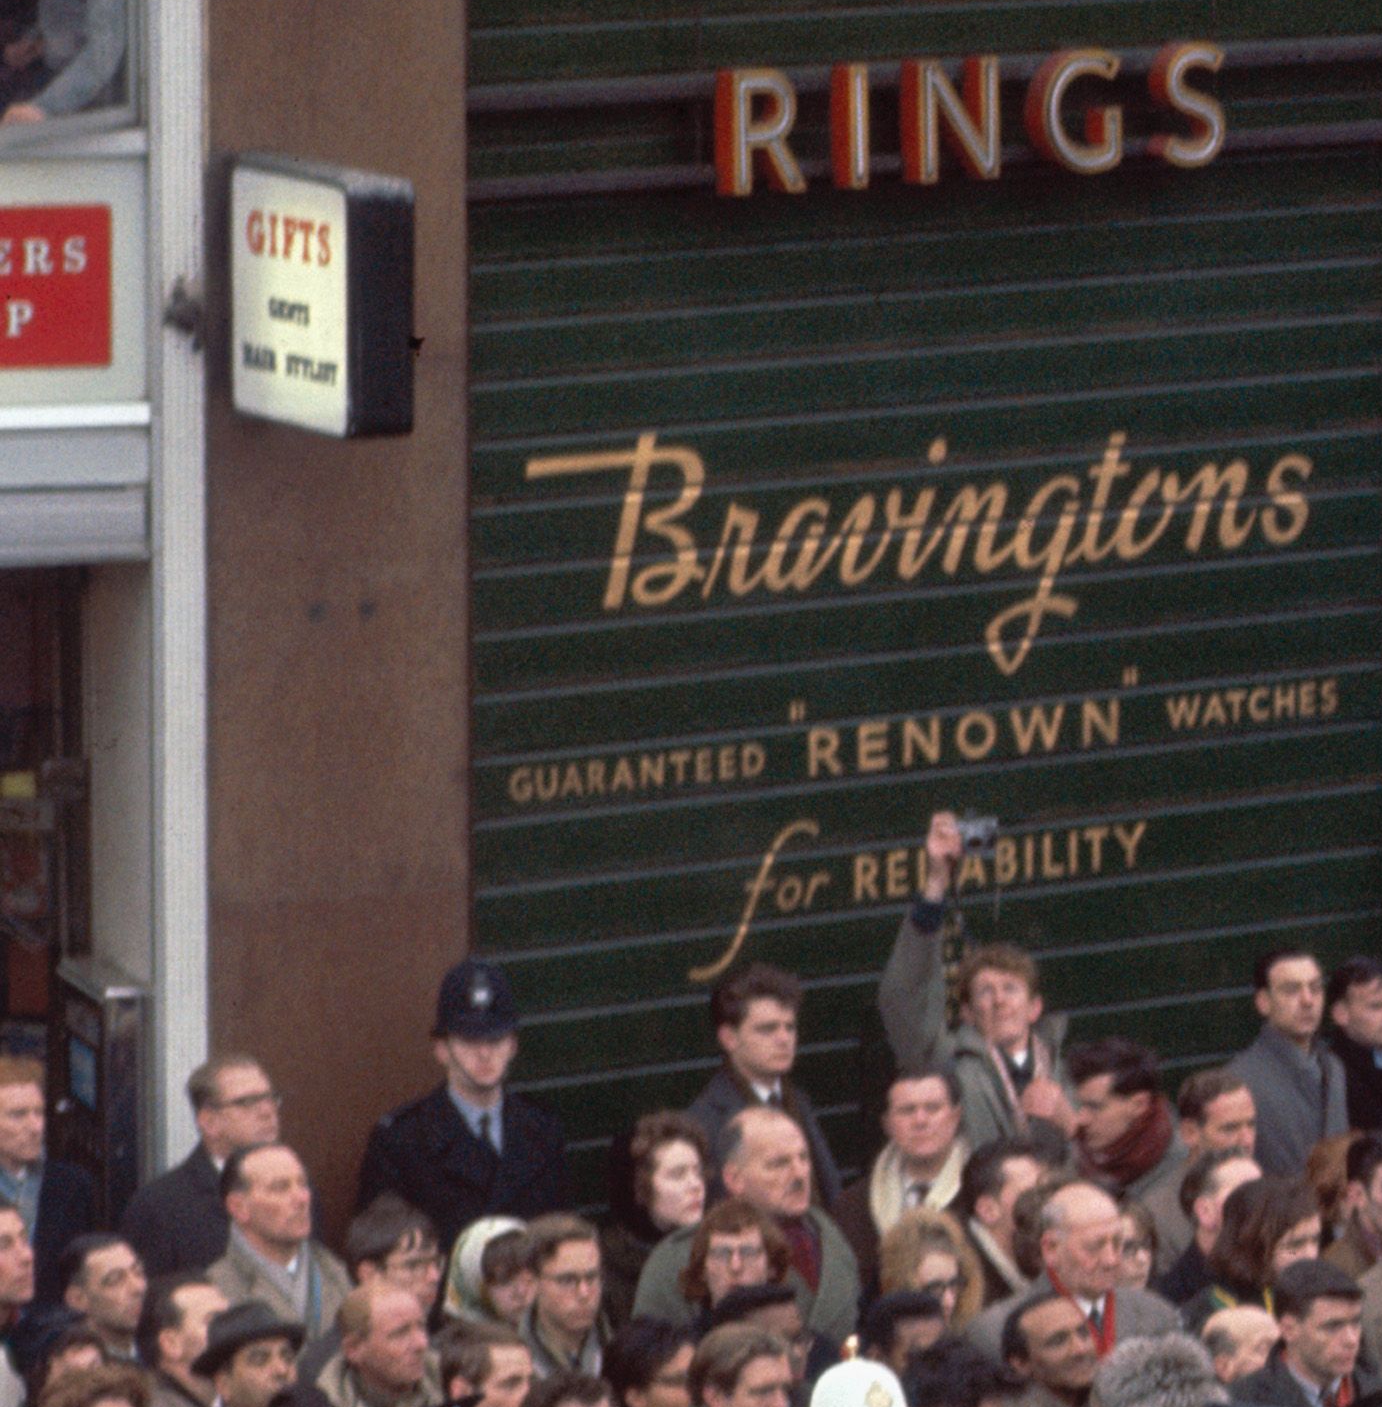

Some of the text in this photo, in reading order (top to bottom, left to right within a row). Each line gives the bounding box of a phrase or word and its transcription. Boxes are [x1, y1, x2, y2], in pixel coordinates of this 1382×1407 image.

[712, 41, 1228, 198] RINGS
[245, 208, 332, 268] GIFTS
[526, 431, 1315, 676] Bravingtons
[509, 743, 767, 804] GUARANTEED
[1164, 678, 1340, 730] WATCHES
[687, 819, 1147, 983] for RELABILITY
